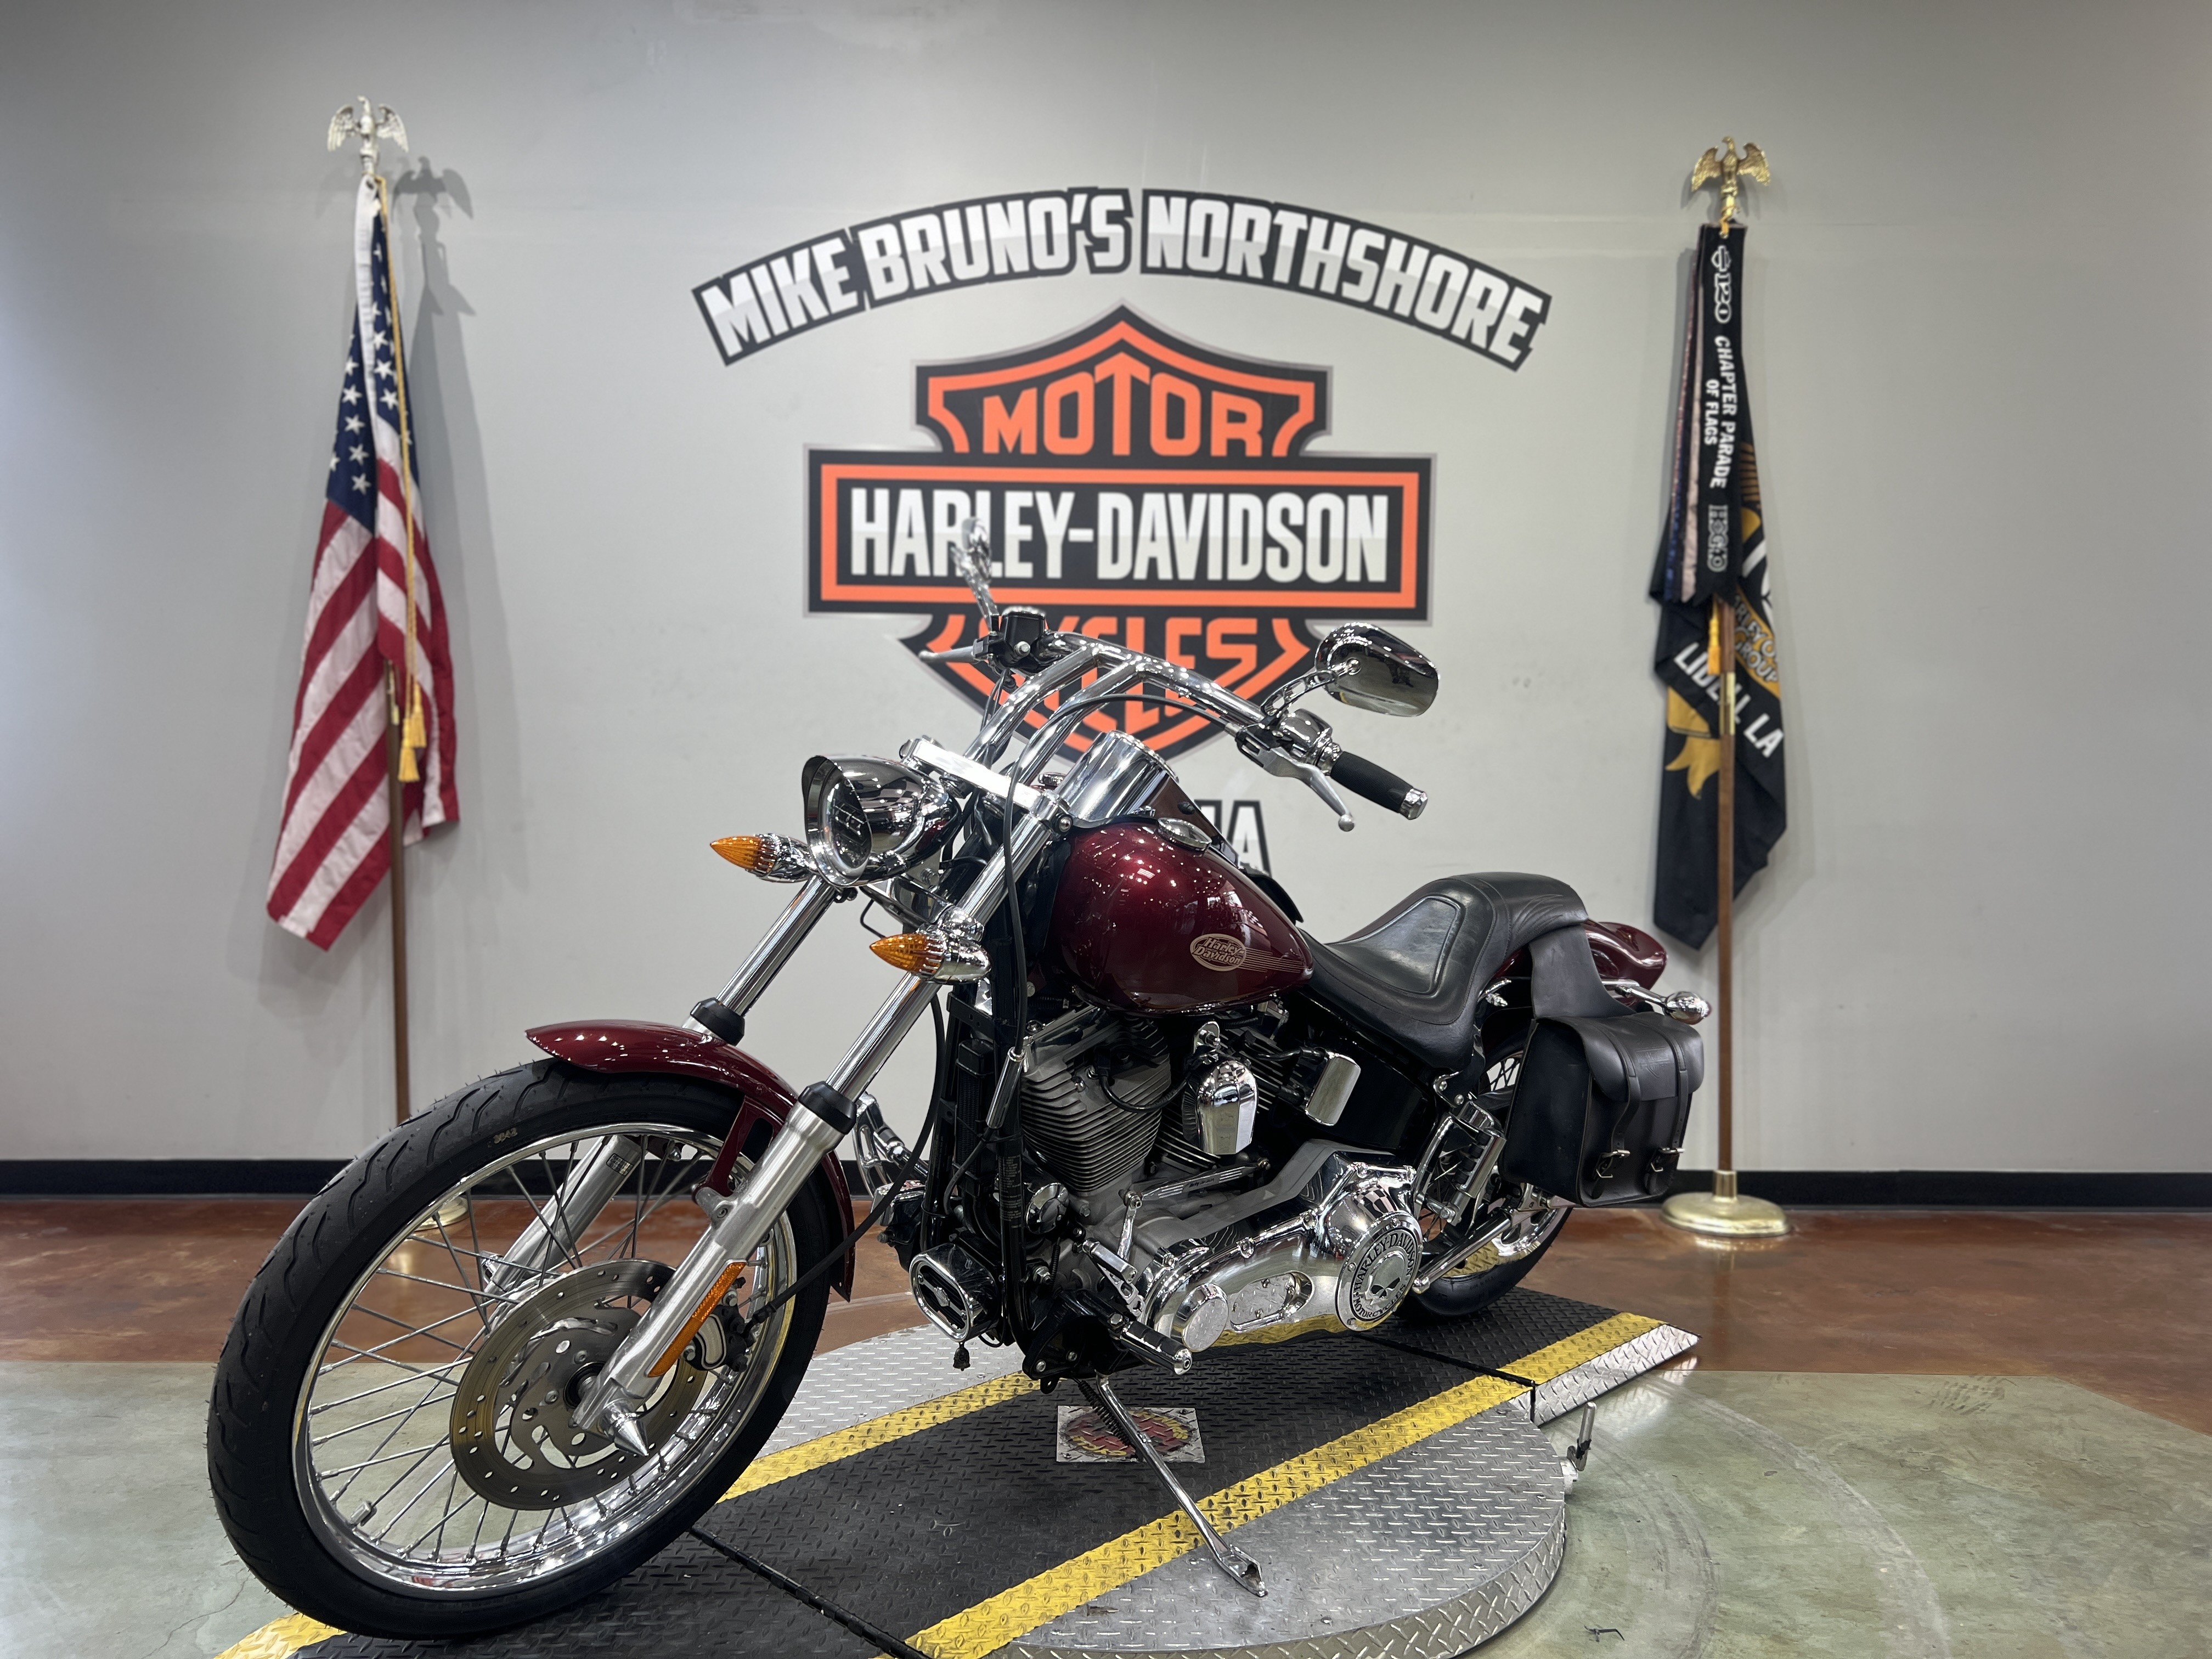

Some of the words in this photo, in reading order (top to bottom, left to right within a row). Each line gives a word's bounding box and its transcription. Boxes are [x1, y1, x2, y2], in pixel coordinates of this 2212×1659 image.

[700, 236, 859, 358] MIKE
[857, 193, 1126, 301] BRUNO'S
[1146, 195, 1544, 364] NORTHSHORE
[983, 351, 1263, 458] MOTOR
[1706, 379, 1720, 397] OF
[1714, 335, 1738, 416] CHAPTER
[1704, 402, 1719, 445] FLAGS
[1709, 420, 1735, 489] PARADE
[851, 488, 1388, 583] HARLEY-DAVIDSON
[1743, 713, 1784, 758] LA
[1193, 945, 1242, 965] Davidson
[1354, 1232, 1415, 1291] HARLEY-DAVIDSON
